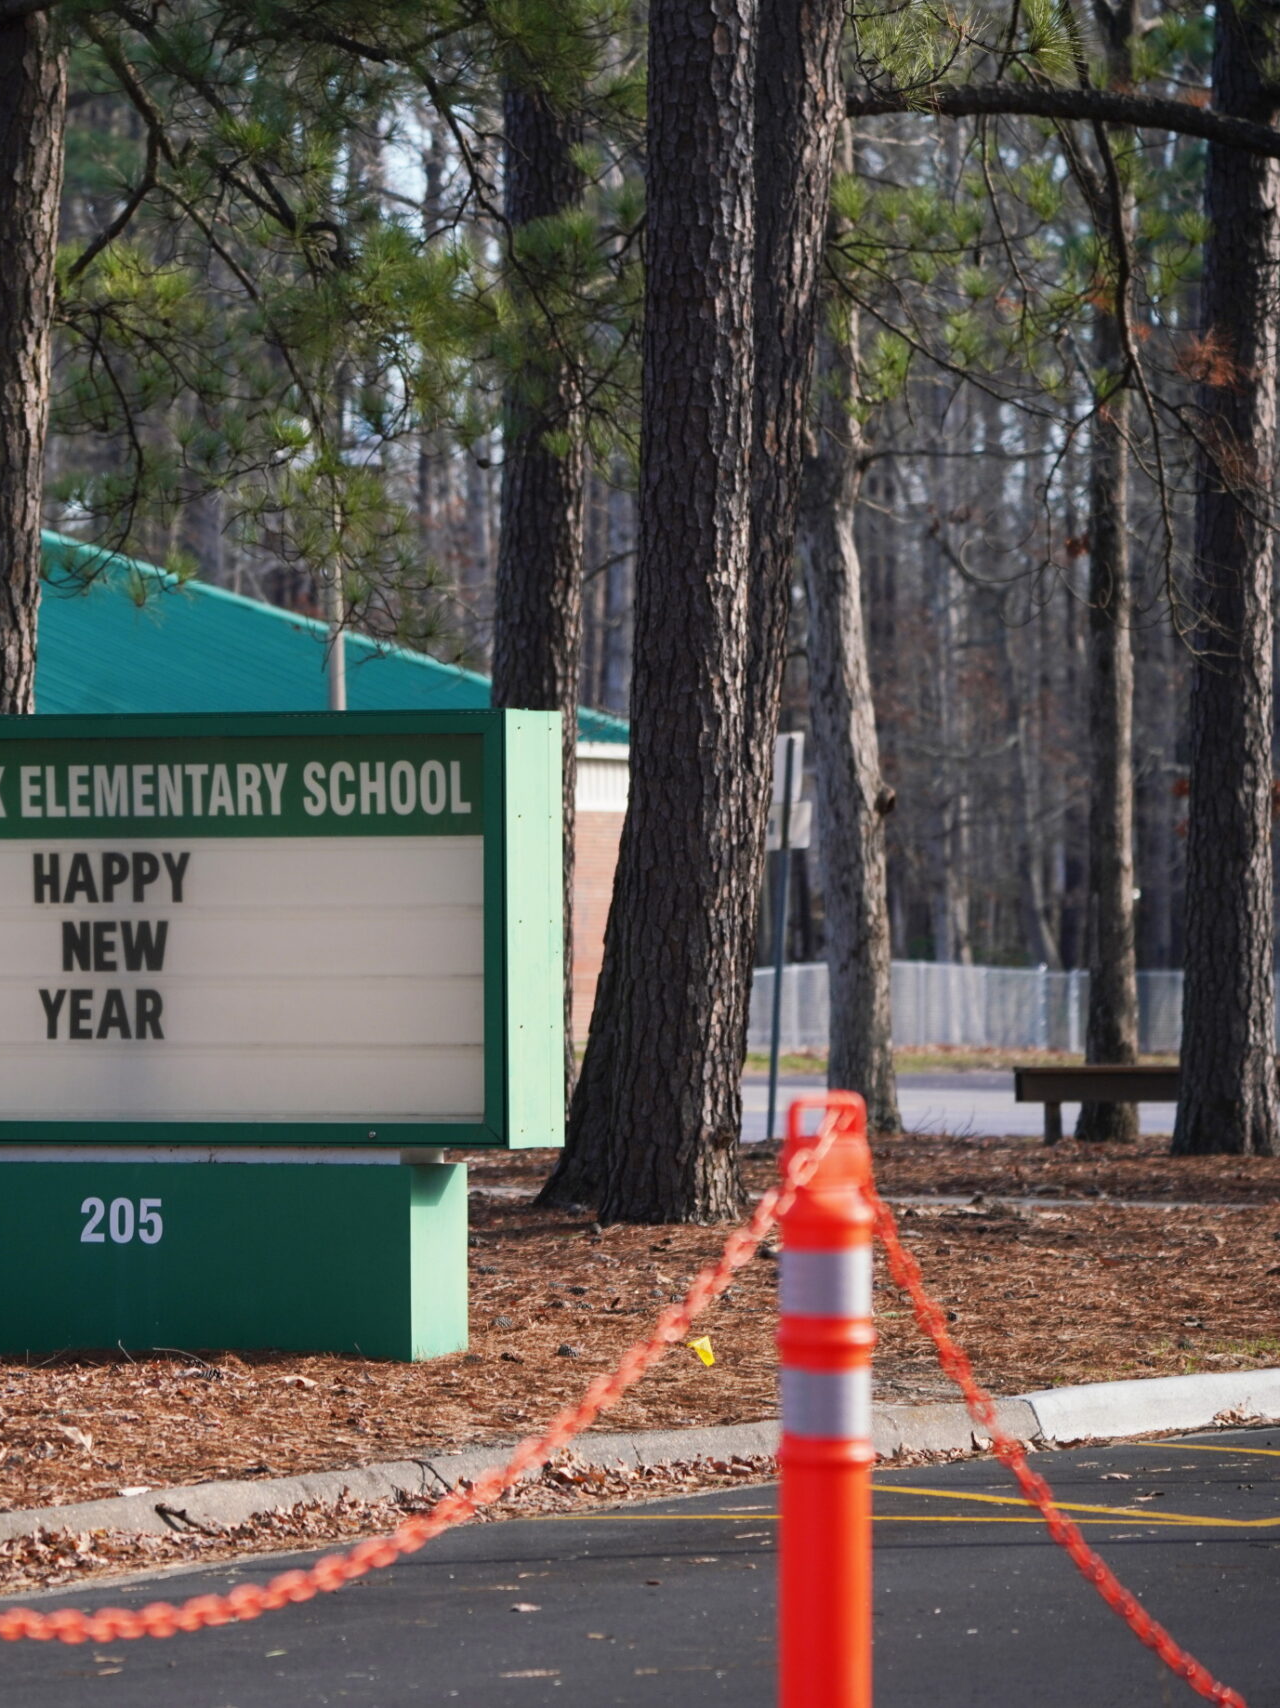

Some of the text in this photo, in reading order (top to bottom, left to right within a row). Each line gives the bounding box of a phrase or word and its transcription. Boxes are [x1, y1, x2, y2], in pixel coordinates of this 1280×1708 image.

[20, 763, 288, 819] ELEMENTARY
[302, 759, 472, 815] SCHOOL
[32, 852, 191, 904] HAPPY
[61, 920, 169, 972] NEW
[38, 988, 165, 1040] YEAR
[79, 1197, 164, 1245] 205
